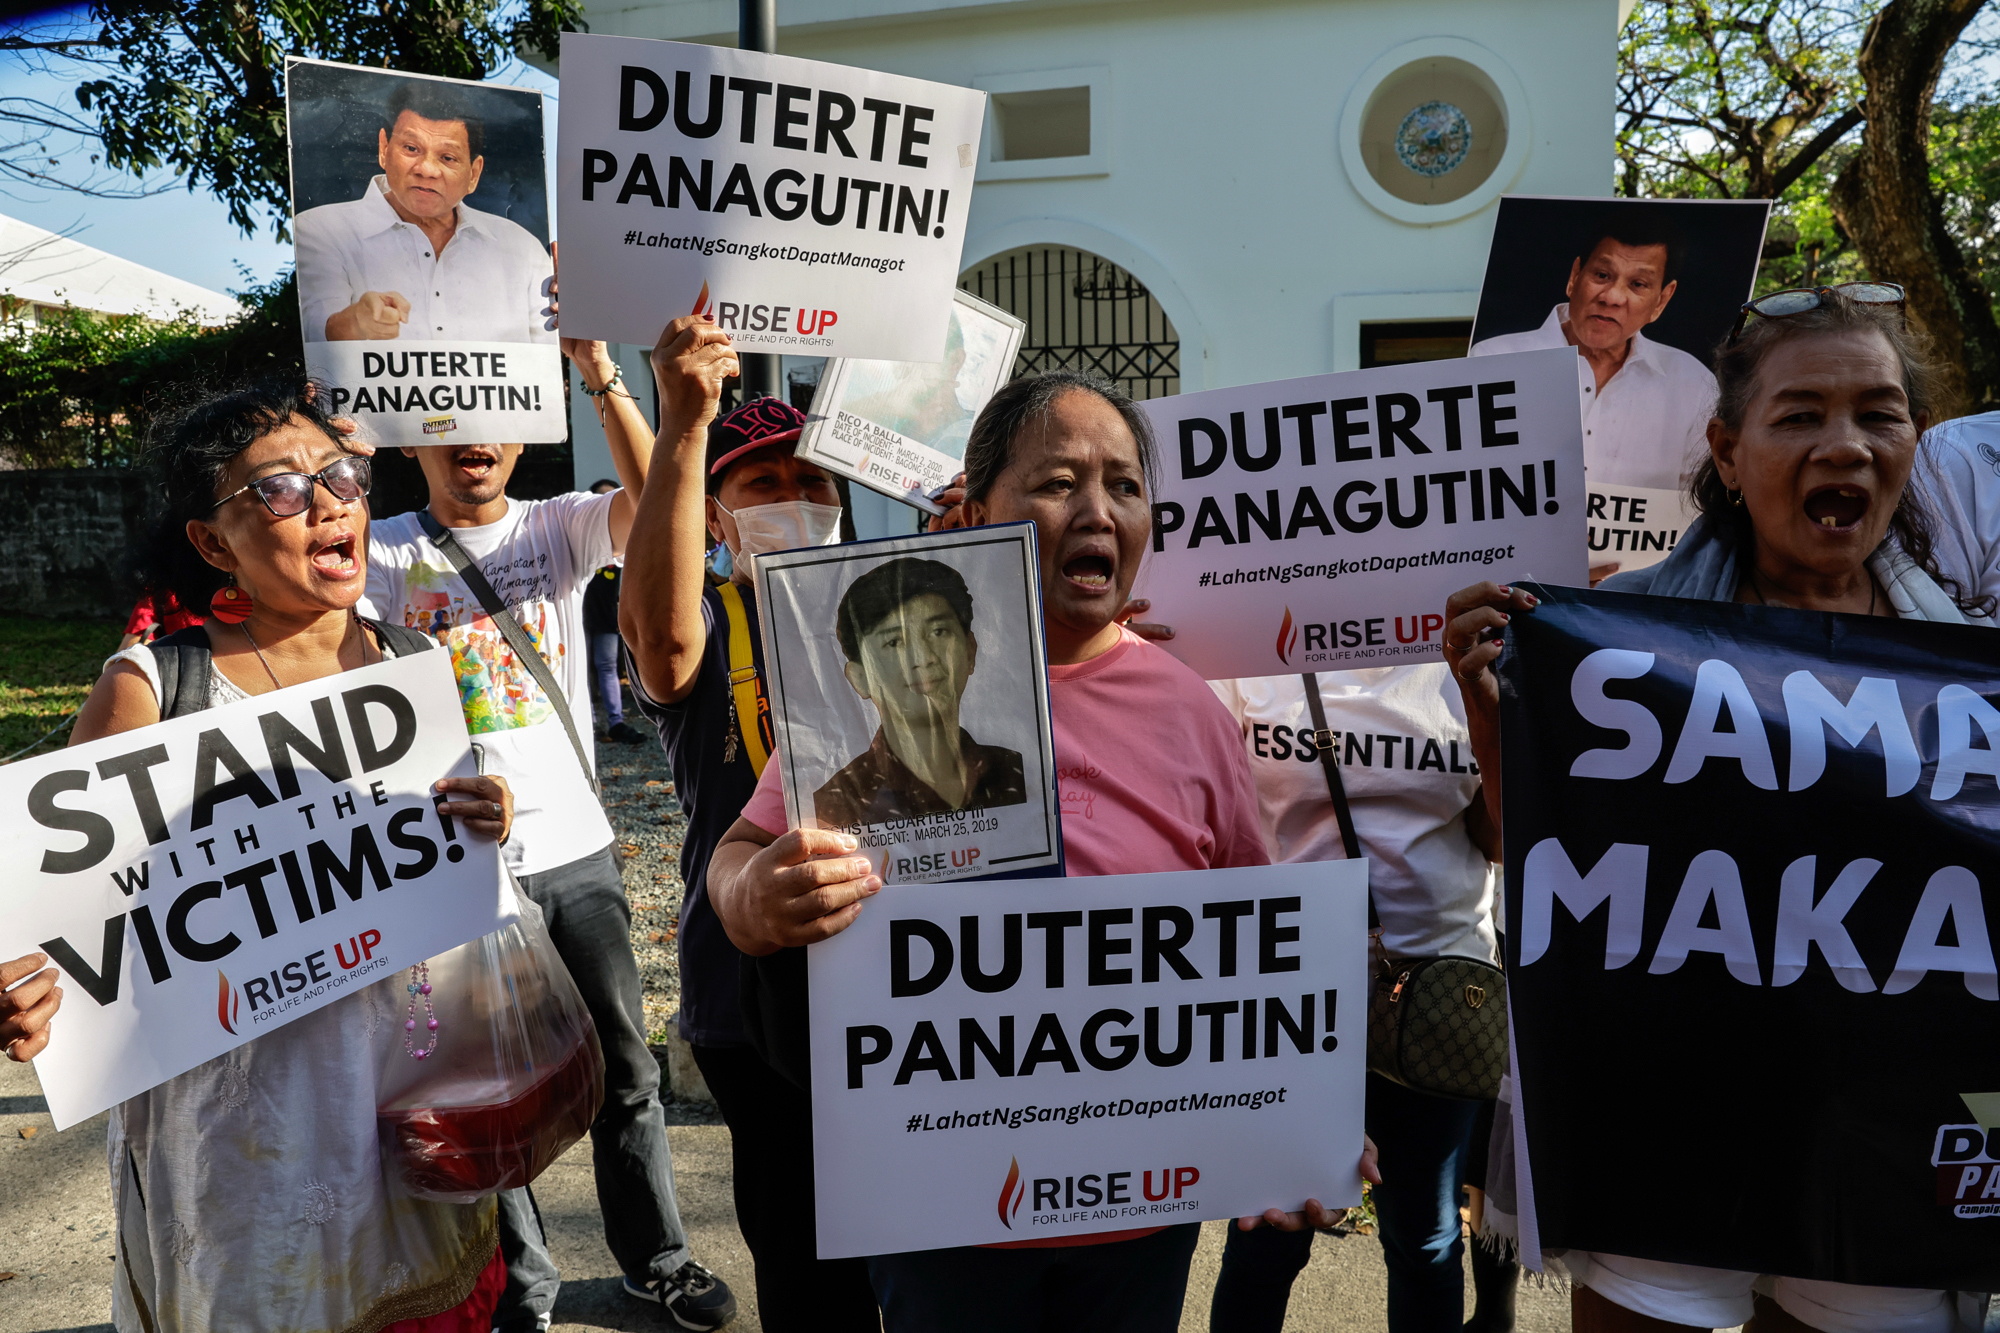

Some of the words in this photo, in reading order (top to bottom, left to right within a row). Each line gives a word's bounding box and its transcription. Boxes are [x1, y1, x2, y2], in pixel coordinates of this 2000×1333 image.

[618, 65, 934, 169] DUTERTE
[582, 148, 949, 239] PANAGUTIN!
[624, 230, 905, 272] #LahatNgSangkotDapatManagot
[719, 302, 791, 332] RISE
[797, 308, 838, 336] UP
[737, 333, 756, 342] LIFE
[758, 335, 776, 344] AND
[779, 336, 797, 345] FOR
[800, 338, 834, 347] RIGHTS!
[363, 352, 507, 378] DUTERTE
[331, 385, 542, 414] PANAGUTIN!
[834, 420, 852, 434] DATE
[853, 428, 862, 437] OF
[863, 432, 894, 452] INCIDENT:
[897, 447, 919, 462] MARCH
[927, 460, 943, 473] 2020
[837, 411, 862, 427] RICO
[863, 423, 870, 432] A
[873, 426, 902, 446] BALLA
[1178, 381, 1519, 480] DUTERTE
[831, 429, 853, 444] PLACE
[853, 438, 863, 448] OF
[863, 442, 895, 462] INCIDENT:
[895, 456, 921, 474] BAGONG
[869, 463, 902, 485] RISE
[902, 476, 921, 491] UP
[1152, 460, 1560, 553] PANAGUTIN!
[1587, 493, 1647, 523] RTE
[1588, 526, 1678, 552] UTIN!
[1199, 545, 1515, 588] #LahatNgSangkotDapatManagot
[1304, 618, 1386, 651] RISE
[1395, 614, 1444, 643] UP
[1305, 653, 1326, 662] FOR
[1330, 651, 1350, 661] LIFE
[1354, 649, 1375, 659] AND
[1379, 647, 1400, 656] FOR
[1403, 643, 1443, 655] RIGHTS
[27, 684, 417, 874] STAND
[110, 824, 261, 896] WITH
[298, 780, 388, 830] THE
[860, 830, 909, 848] INCIDENT:
[915, 825, 951, 841] MARCH
[953, 822, 970, 836] 25,
[972, 818, 998, 833] 2019
[867, 821, 880, 833] L.
[885, 808, 966, 831] CUARTERO
[971, 805, 984, 819] III
[897, 853, 947, 875] RISE
[951, 848, 981, 867] UP
[957, 866, 982, 874] RIGHTS!
[39, 793, 465, 1006] VICTIMS!
[1520, 838, 2000, 1000] MAKA
[889, 896, 1301, 998] DUTERTE
[243, 950, 332, 1012] RISE
[334, 929, 381, 970] UP
[253, 1008, 277, 1024] FOR
[278, 996, 301, 1013] LIFE
[303, 985, 325, 1001] AND
[326, 975, 348, 990] FOR
[350, 956, 389, 980] RIGHTS!
[846, 989, 1338, 1089] PANAGUTIN!
[906, 1086, 1287, 1133] #LahatNgSangkotDapatManagot
[1033, 1172, 1131, 1211] RISE
[1142, 1167, 1200, 1201] UP
[1955, 1165, 2000, 1199] PA
[1033, 1214, 1058, 1225] FOR
[1062, 1212, 1088, 1223] LIFE
[1092, 1209, 1117, 1220] AND
[1122, 1206, 1146, 1217] FOR
[1150, 1200, 1199, 1214] RIGHTS!
[1959, 1205, 2000, 1215] Campaig
